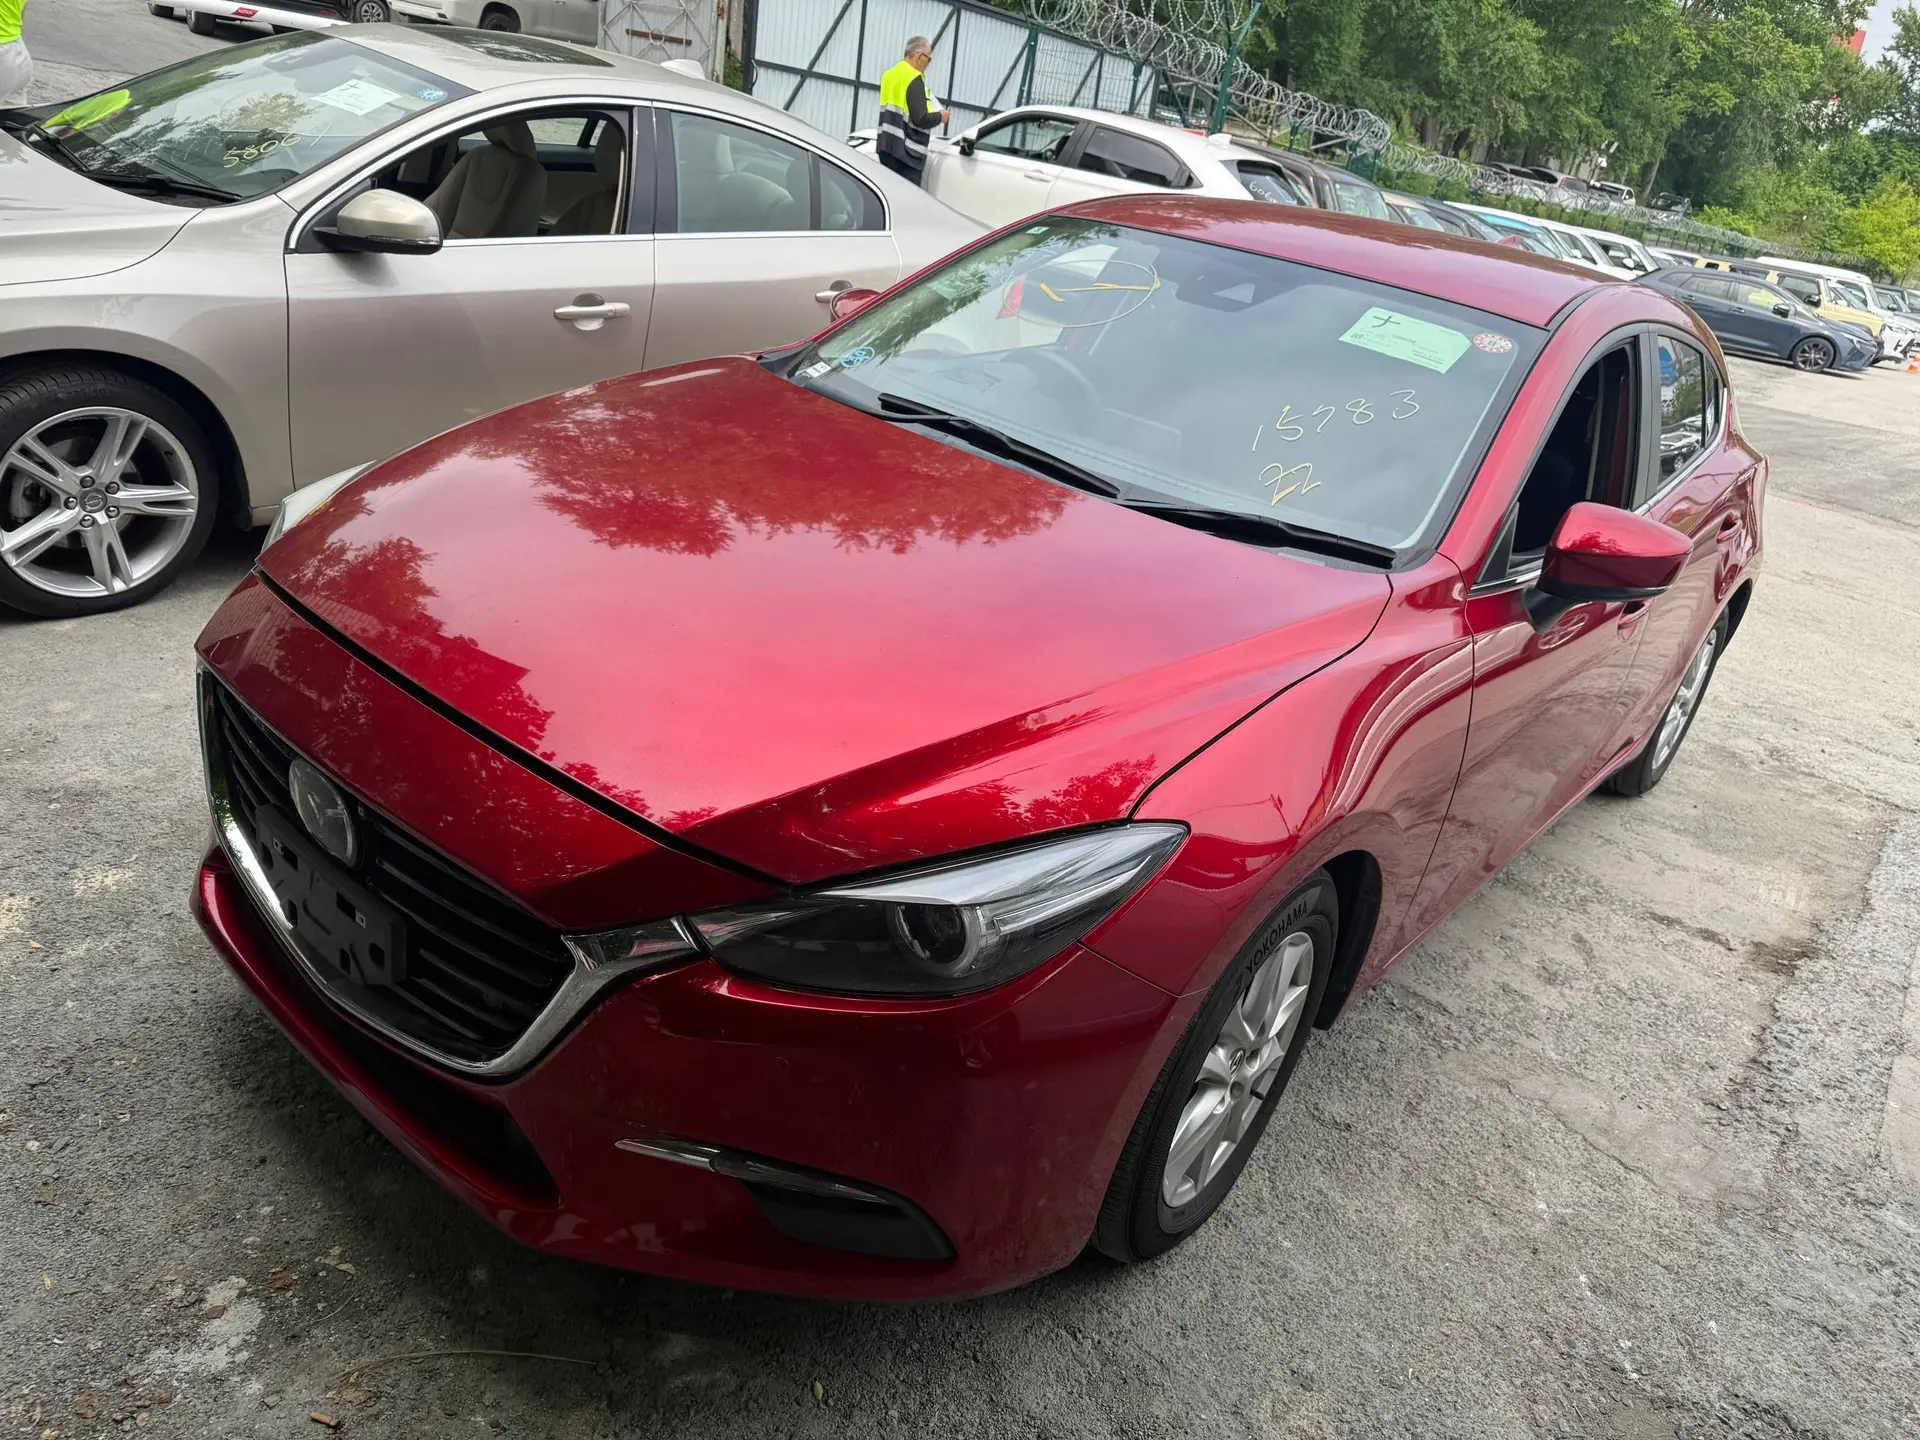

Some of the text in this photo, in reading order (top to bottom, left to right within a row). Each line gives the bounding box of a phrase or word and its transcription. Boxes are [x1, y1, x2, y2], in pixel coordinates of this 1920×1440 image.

[1252, 389, 1420, 453] 15783
[1258, 462, 1322, 507] 22
[1244, 900, 1308, 975] YOKOHAMA
